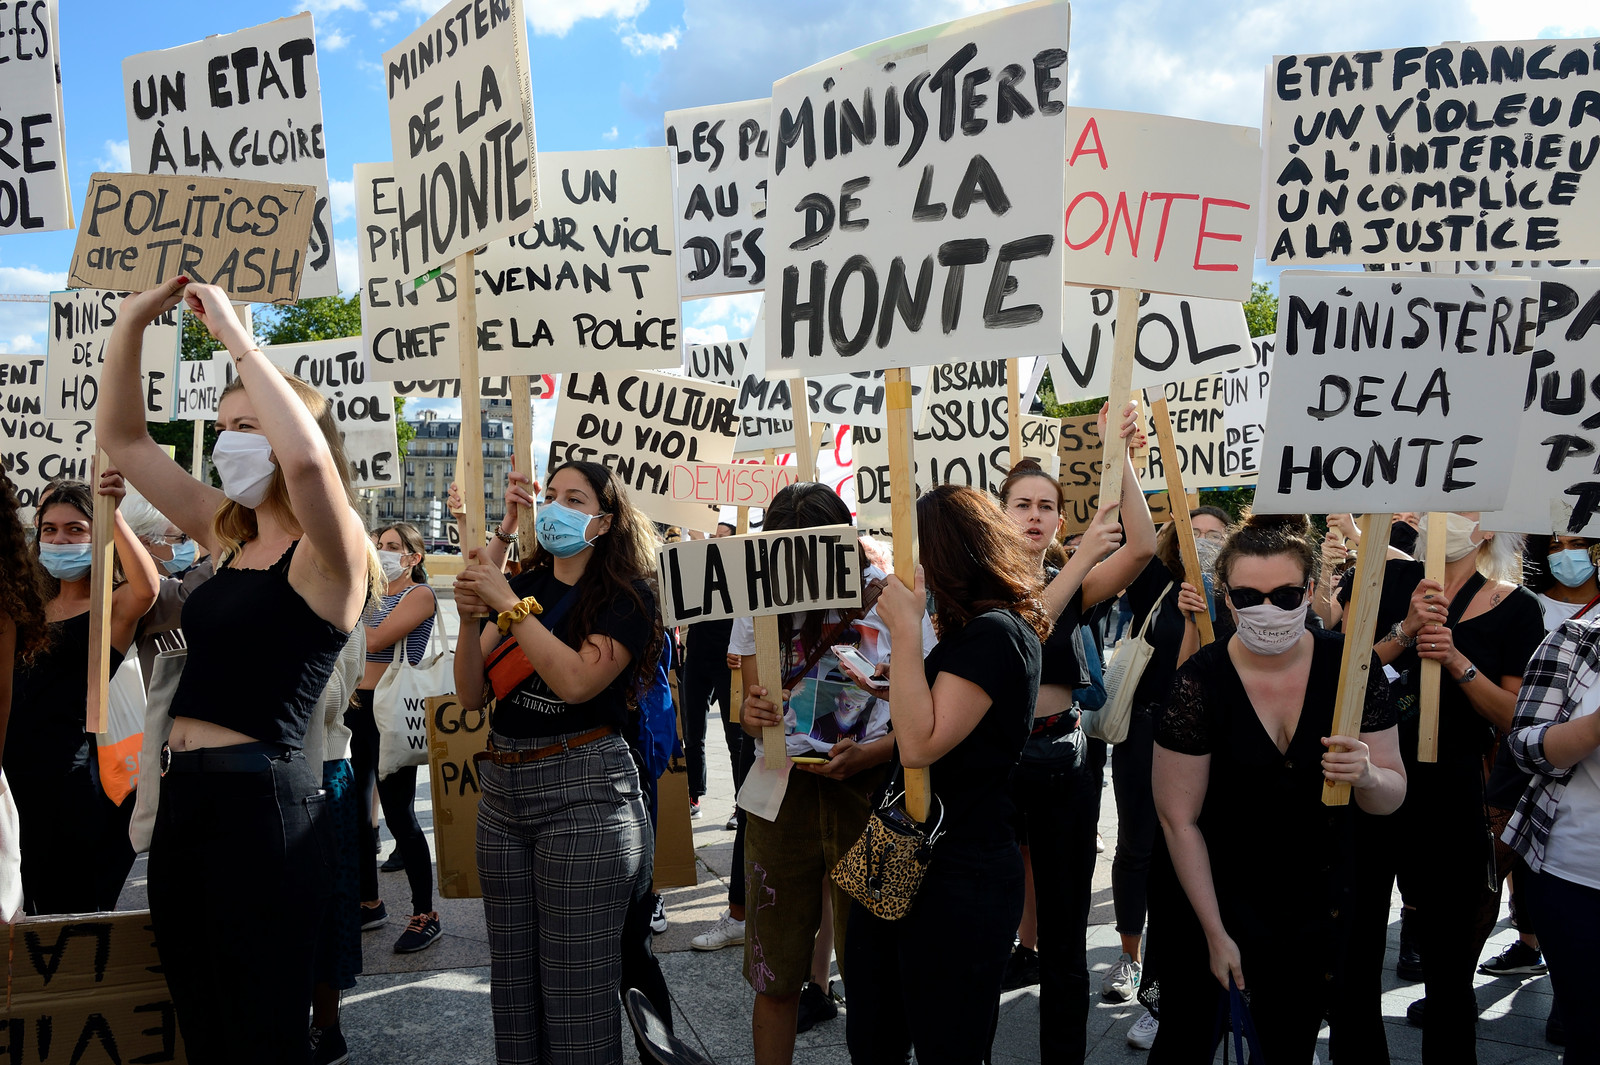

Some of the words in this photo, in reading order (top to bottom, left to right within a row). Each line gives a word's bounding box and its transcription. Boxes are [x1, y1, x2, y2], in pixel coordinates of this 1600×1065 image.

[132, 71, 187, 120] UN
[207, 37, 315, 108] ETAT
[1277, 50, 1383, 101] ETAT
[408, 96, 444, 158] DE
[455, 65, 502, 134] LA
[1294, 104, 1365, 146] UN
[148, 119, 178, 175] À
[183, 126, 223, 173] LA
[667, 119, 726, 173] LES
[1277, 143, 1313, 187] À
[399, 118, 532, 275] HONTE
[562, 169, 617, 205] UN
[684, 182, 738, 222] AU
[789, 176, 870, 250] DE
[912, 154, 1012, 222] LA
[1278, 183, 1349, 222] UN
[683, 228, 766, 285] DES
[1270, 228, 1296, 261] A
[1306, 220, 1352, 258] LA
[87, 246, 139, 271] are
[147, 238, 299, 295] TRASH
[436, 261, 650, 302] DVENANT
[781, 234, 1054, 359] HONTE
[72, 342, 92, 368] DE
[373, 322, 450, 364] CHEF
[477, 319, 503, 351] E
[510, 317, 555, 348] LA
[692, 344, 734, 378] UN
[1062, 301, 1242, 388] VOL
[61, 371, 166, 413] HOE
[190, 362, 205, 384] LA
[739, 373, 922, 415] MARCH
[1224, 375, 1249, 406] UN
[1307, 374, 1384, 421] DE
[1391, 367, 1451, 417] LA
[178, 386, 217, 413] HONTE
[567, 371, 609, 405] LA
[617, 375, 741, 438] CULTURE
[73, 420, 92, 452] ?
[576, 413, 622, 446] DU
[635, 425, 703, 462] VIOL
[1227, 447, 1256, 473] DE
[1278, 434, 1483, 494] HONTE
[673, 465, 797, 503] DEMISSIO
[857, 461, 921, 504] DE
[543, 523, 556, 532] LA
[669, 543, 734, 620] LA
[744, 534, 857, 611] HONTE
[435, 702, 493, 734] GO
[24, 922, 112, 987] LA
